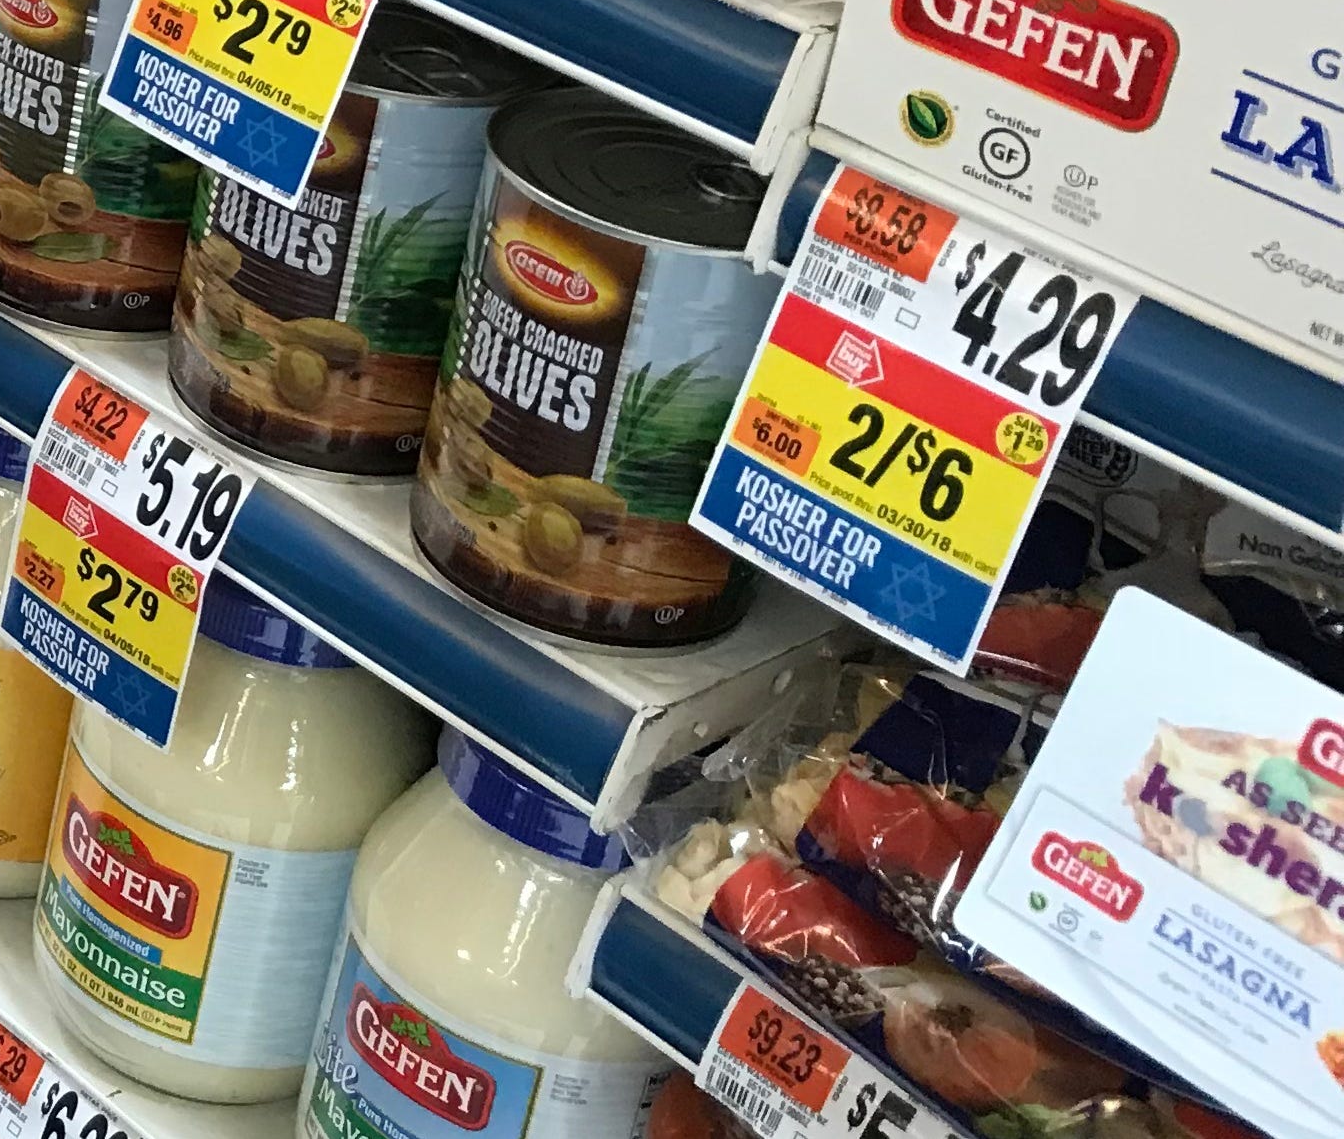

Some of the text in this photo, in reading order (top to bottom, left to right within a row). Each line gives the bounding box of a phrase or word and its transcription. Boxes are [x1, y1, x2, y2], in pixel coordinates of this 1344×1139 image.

[146, 5, 185, 42] $4.96
[12, 44, 64, 84] PITTED
[134, 49, 241, 127] KOSHER FOR
[236, 69, 292, 108] 04/05/18
[132, 75, 222, 145] PASSOVER
[985, 107, 1041, 139] Certified
[961, 163, 1033, 204] Gluten-Free
[218, 183, 338, 278] OLIVES
[845, 186, 927, 257] $8.58
[482, 288, 605, 376] GREEN CRACKED
[952, 239, 1116, 407] $4.29
[74, 385, 130, 442] $4.22
[469, 324, 598, 434] OLIVES
[751, 416, 803, 462] $6.00
[1014, 413, 1046, 436] SAVE
[135, 431, 244, 562] $5.19
[828, 402, 974, 524] 2/$6
[734, 504, 858, 591] PASSOVER
[735, 464, 883, 570] KOSHER FOR
[877, 500, 952, 555] 03/30/18
[23, 561, 56, 593] $2.27
[20, 592, 111, 676] KOSHER FOR
[22, 624, 98, 692] PASSOVER
[68, 810, 179, 923] GEFEN
[1042, 840, 1133, 913] GEFEN
[45, 880, 187, 1009] Mayonnaise
[81, 899, 151, 958] Homogenized
[1154, 912, 1312, 1030] LASAGNA
[354, 999, 477, 1115] GEFEN
[747, 1007, 822, 1083] $9.23
